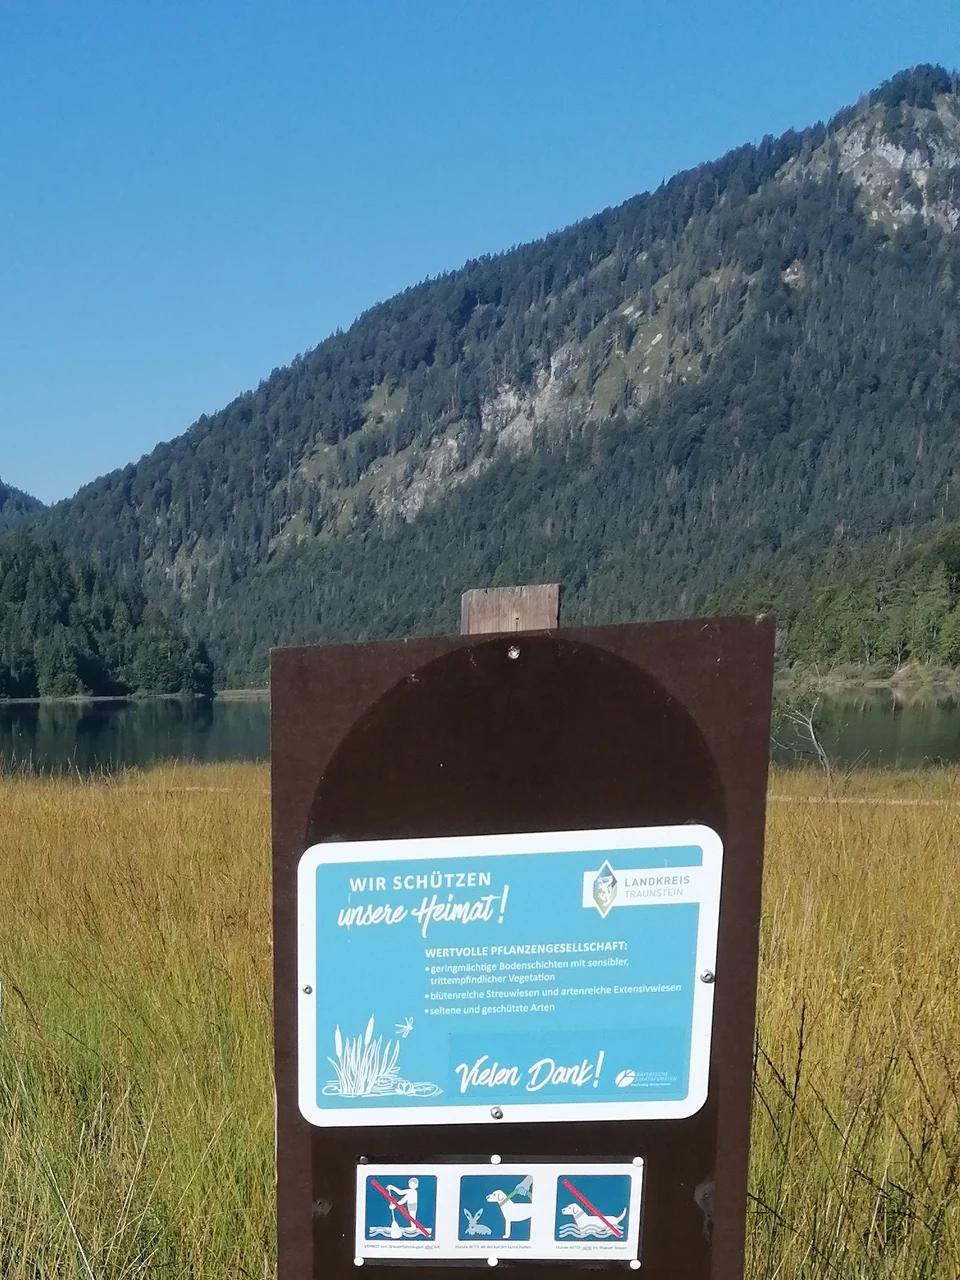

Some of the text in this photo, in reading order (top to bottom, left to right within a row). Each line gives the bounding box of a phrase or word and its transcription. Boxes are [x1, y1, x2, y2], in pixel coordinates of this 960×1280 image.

[349, 870, 492, 892] WIR SCHÜTZEN
[624, 876, 690, 887] LANDKREIS
[624, 888, 684, 898] TRAUNSTEIN
[337, 904, 408, 926] unsere
[425, 941, 628, 958] WERTVOLLE PFLANZENGESELLSCHAFT:
[430, 957, 630, 975] geringmächtige Bodenschichten mit sensibler,
[430, 973, 556, 986] trittempfindlicher Vegetation
[430, 983, 682, 1001] blütenreiche Streuwiesen und artenreiche Extensivwiesen
[430, 1003, 555, 1015] seltene und geschützte Arten
[455, 1050, 605, 1094] Vielen Dank!
